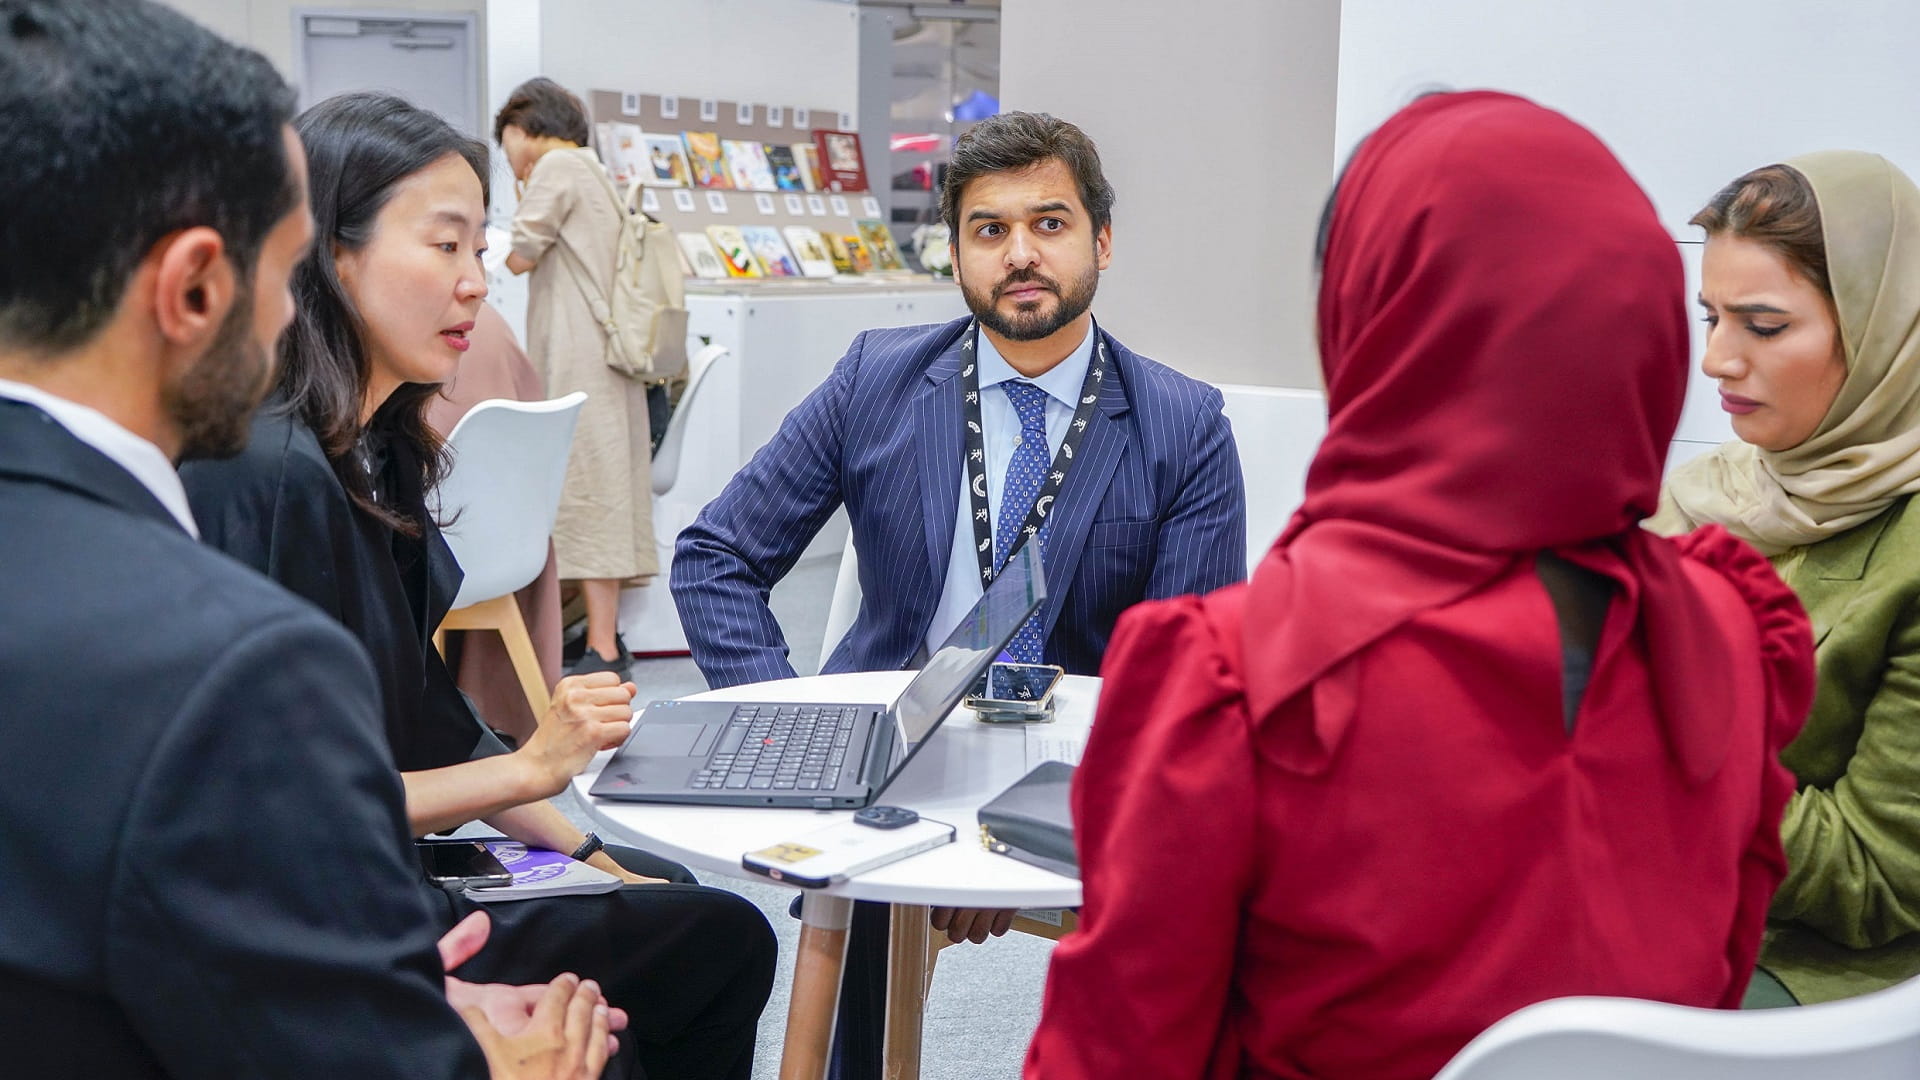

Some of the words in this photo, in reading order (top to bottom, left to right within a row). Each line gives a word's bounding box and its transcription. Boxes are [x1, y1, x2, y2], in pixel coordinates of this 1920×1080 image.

[966, 391, 978, 405] 책
[1073, 417, 1087, 433] 책
[971, 449, 983, 463] 책
[1050, 470, 1064, 486] 책
[976, 508, 988, 522] 책
